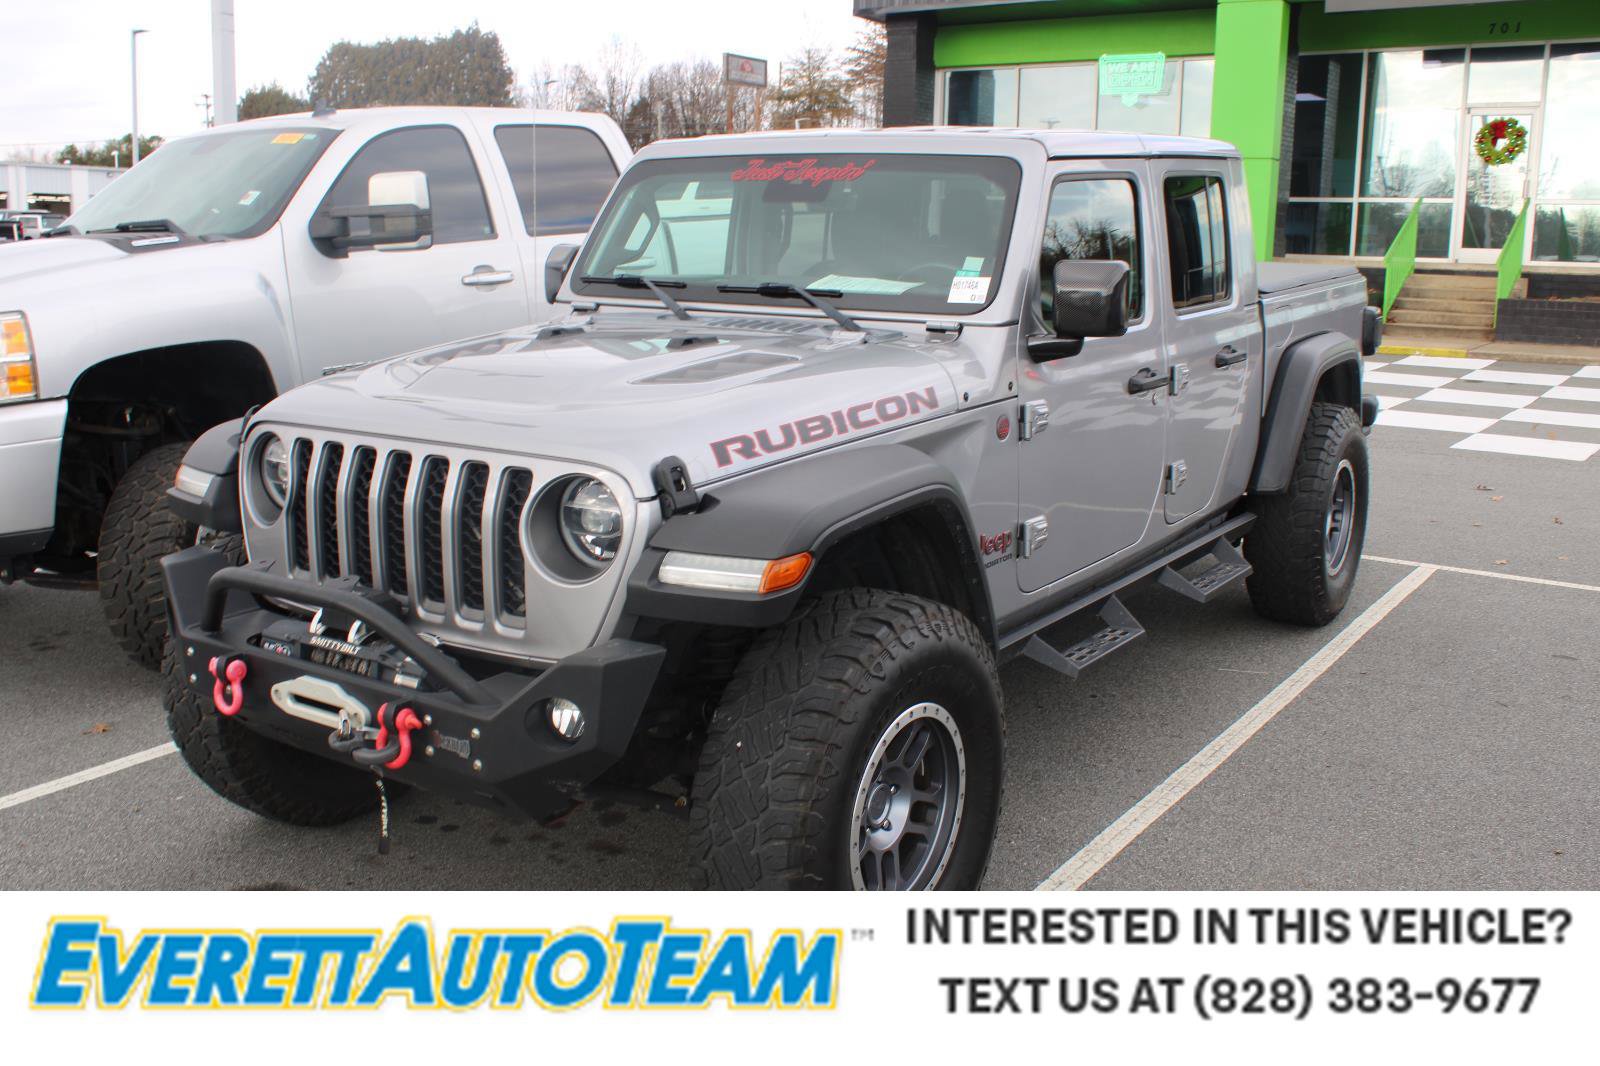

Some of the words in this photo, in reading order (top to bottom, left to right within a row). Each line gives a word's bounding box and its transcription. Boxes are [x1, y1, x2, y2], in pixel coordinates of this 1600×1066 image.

[1488, 21, 1522, 34] 701
[709, 386, 939, 468] RUBICON
[980, 530, 1013, 555] Jeep
[984, 553, 1013, 568] DIATOR
